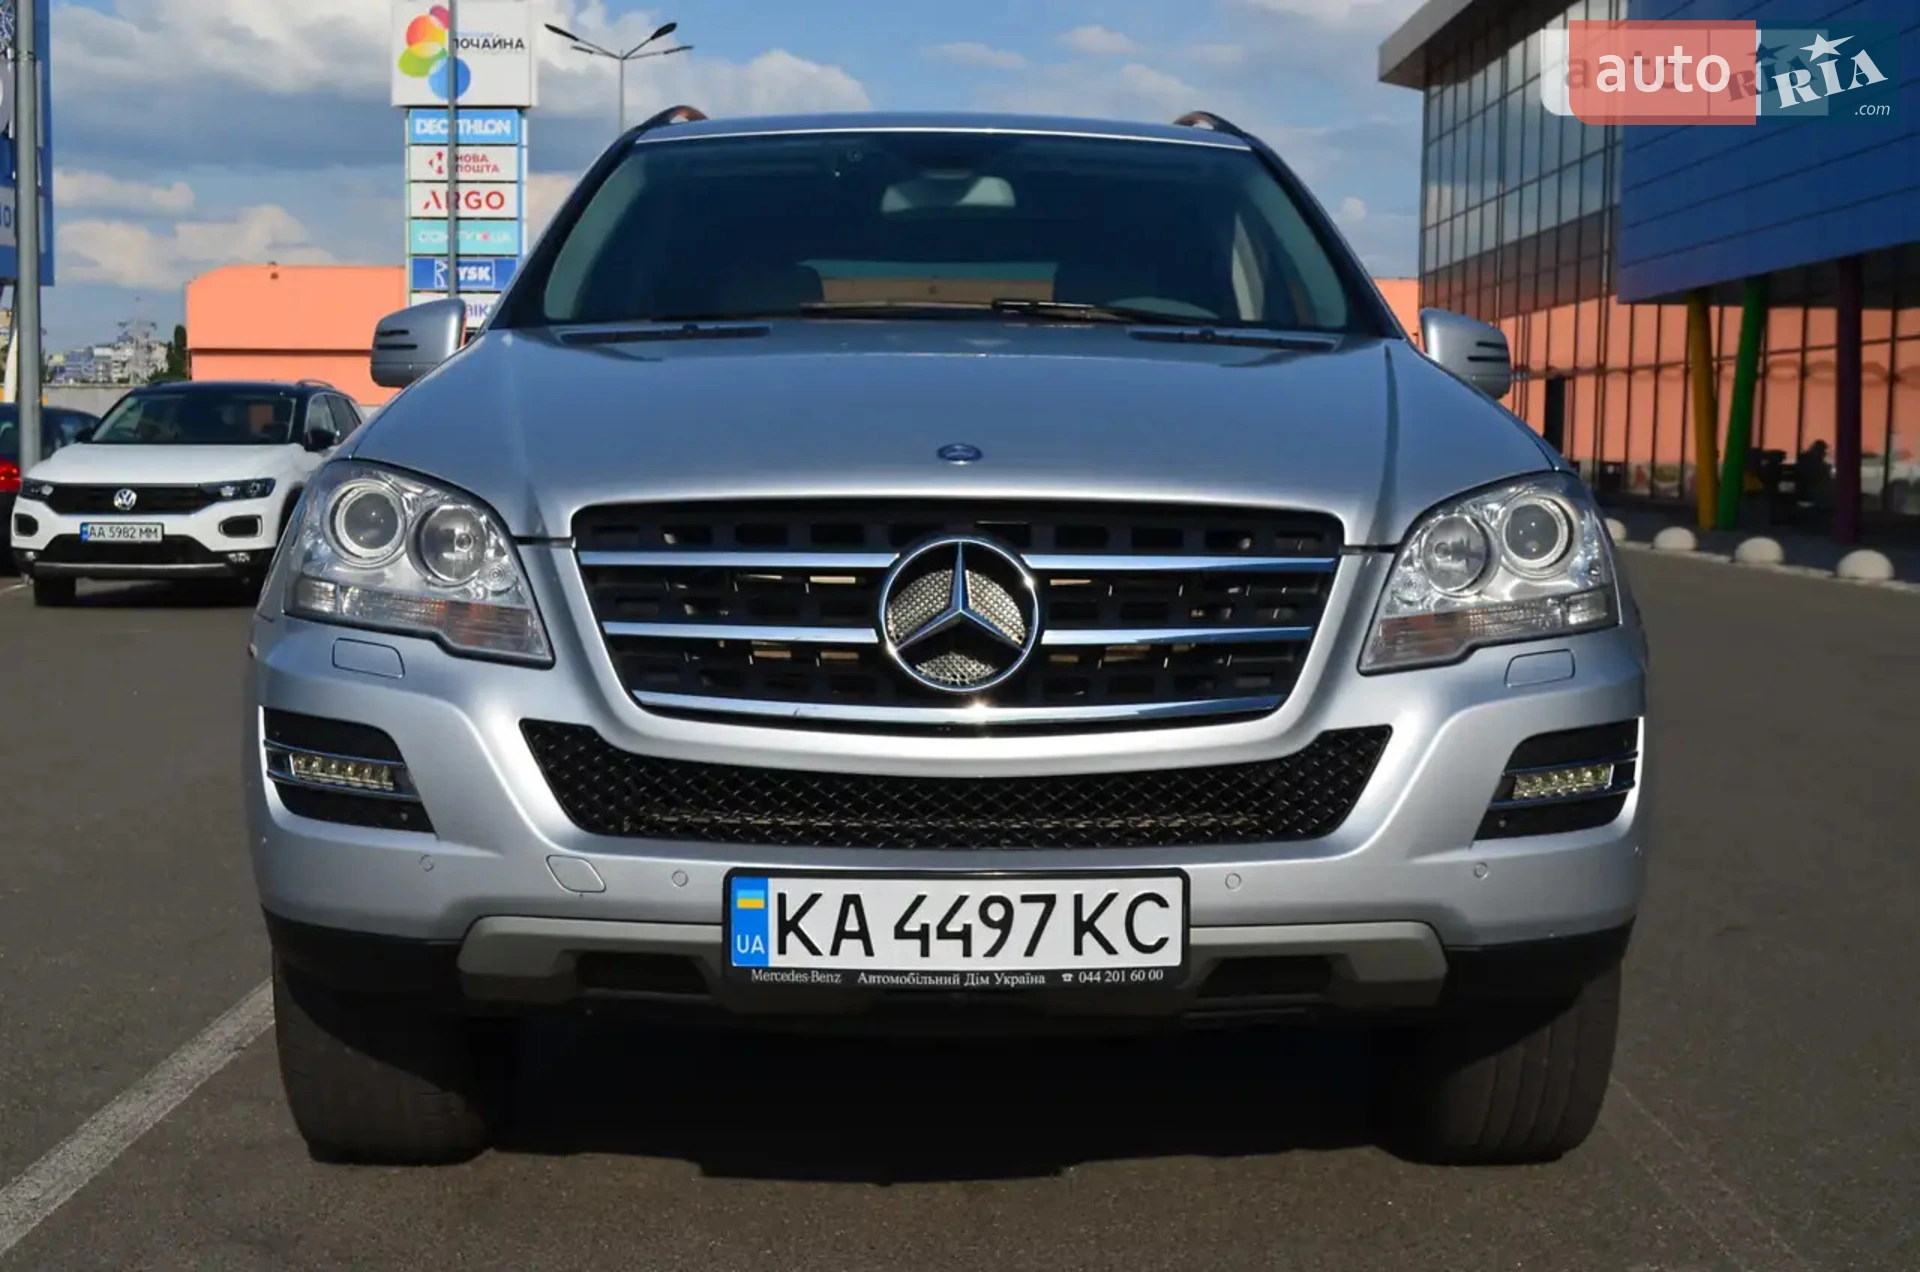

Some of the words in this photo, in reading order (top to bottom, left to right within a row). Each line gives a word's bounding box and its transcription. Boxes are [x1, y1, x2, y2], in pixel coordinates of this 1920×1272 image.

[415, 119, 511, 134] DECTHLON
[457, 266, 492, 281] YSK
[89, 526, 105, 538] AA
[776, 891, 875, 958] KA
[893, 893, 1057, 959] 4497
[1073, 891, 1171, 957] KC
[736, 934, 765, 955] UA
[751, 968, 842, 984] Mercedes-Benz
[857, 971, 960, 986] Автомобільний
[964, 973, 990, 986] Дім
[993, 972, 1046, 988] Україна
[1078, 970, 1101, 983] 044
[1104, 969, 1127, 983] 201
[1130, 969, 1145, 982] 60
[1148, 968, 1164, 981] 00
